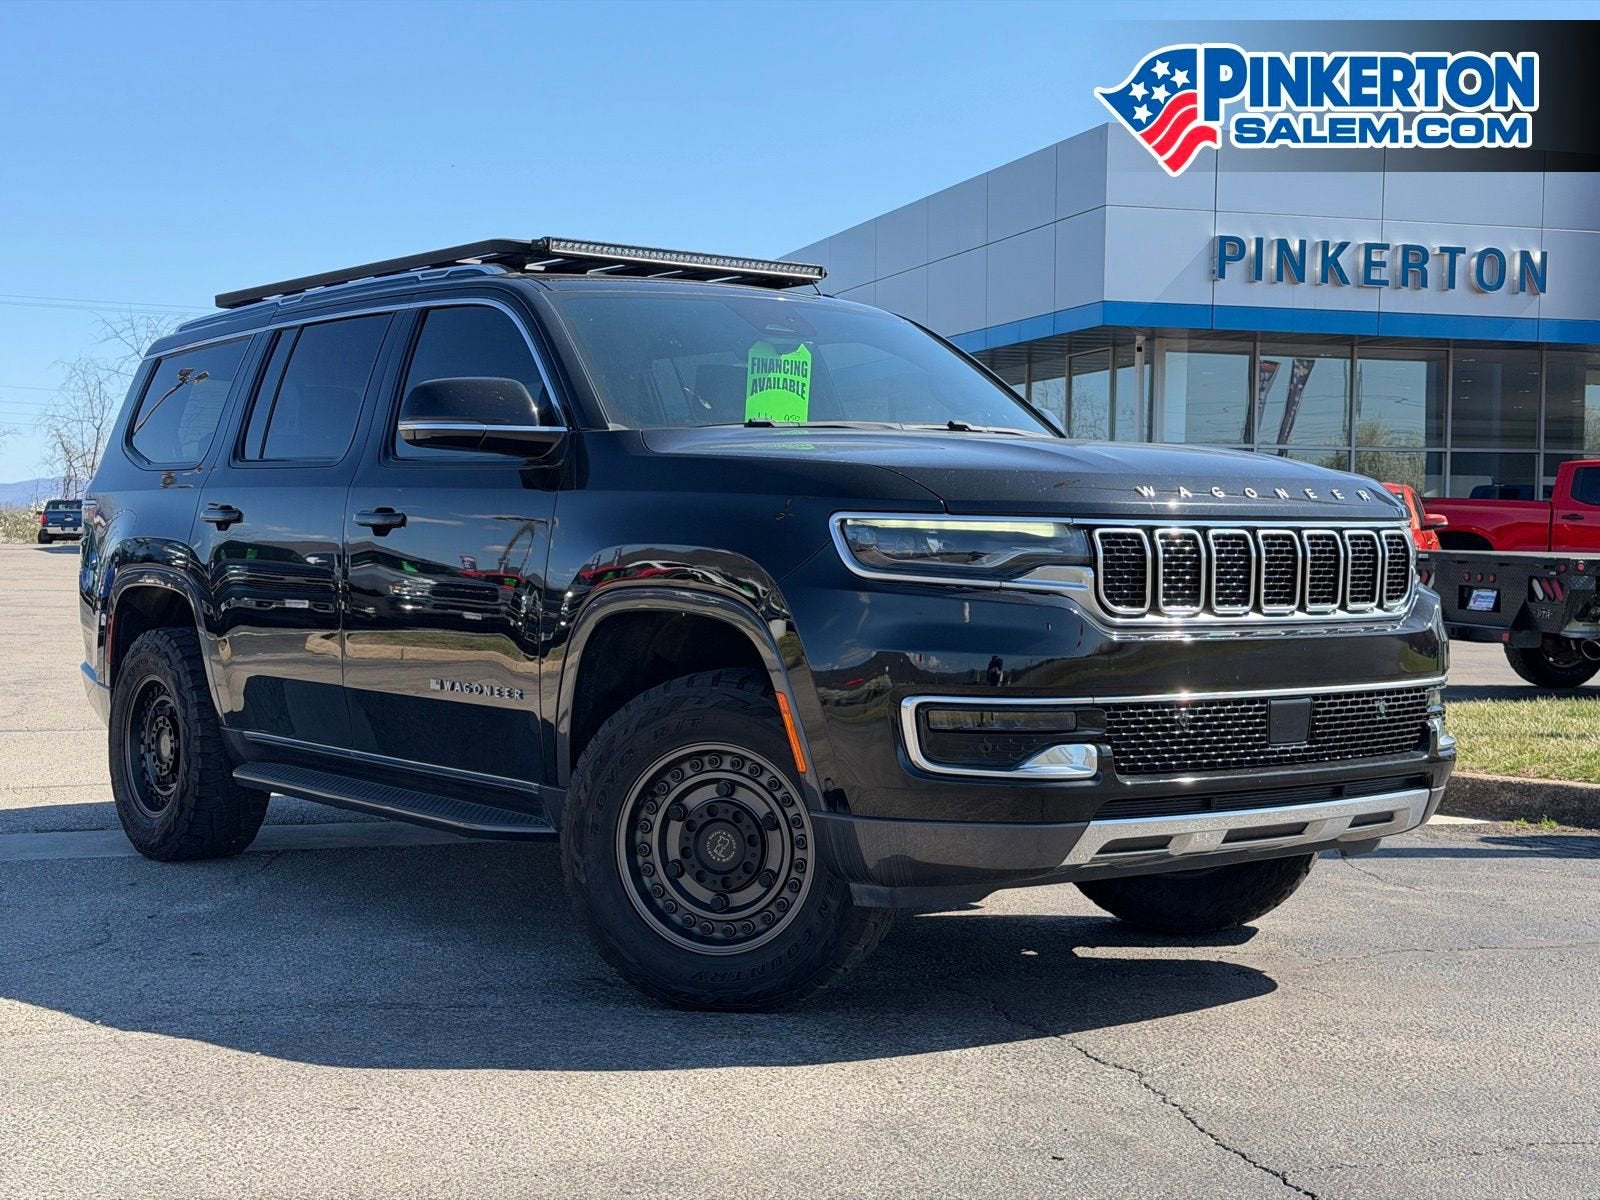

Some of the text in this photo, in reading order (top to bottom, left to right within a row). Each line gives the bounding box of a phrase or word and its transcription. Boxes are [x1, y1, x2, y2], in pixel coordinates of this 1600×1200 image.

[1214, 235, 1548, 295] PINKERTON
[751, 357, 808, 378] FINANCING
[751, 377, 806, 400] AVAILABLE
[1135, 485, 1371, 502] WAGONEER
[443, 681, 524, 700] WAGONEER
